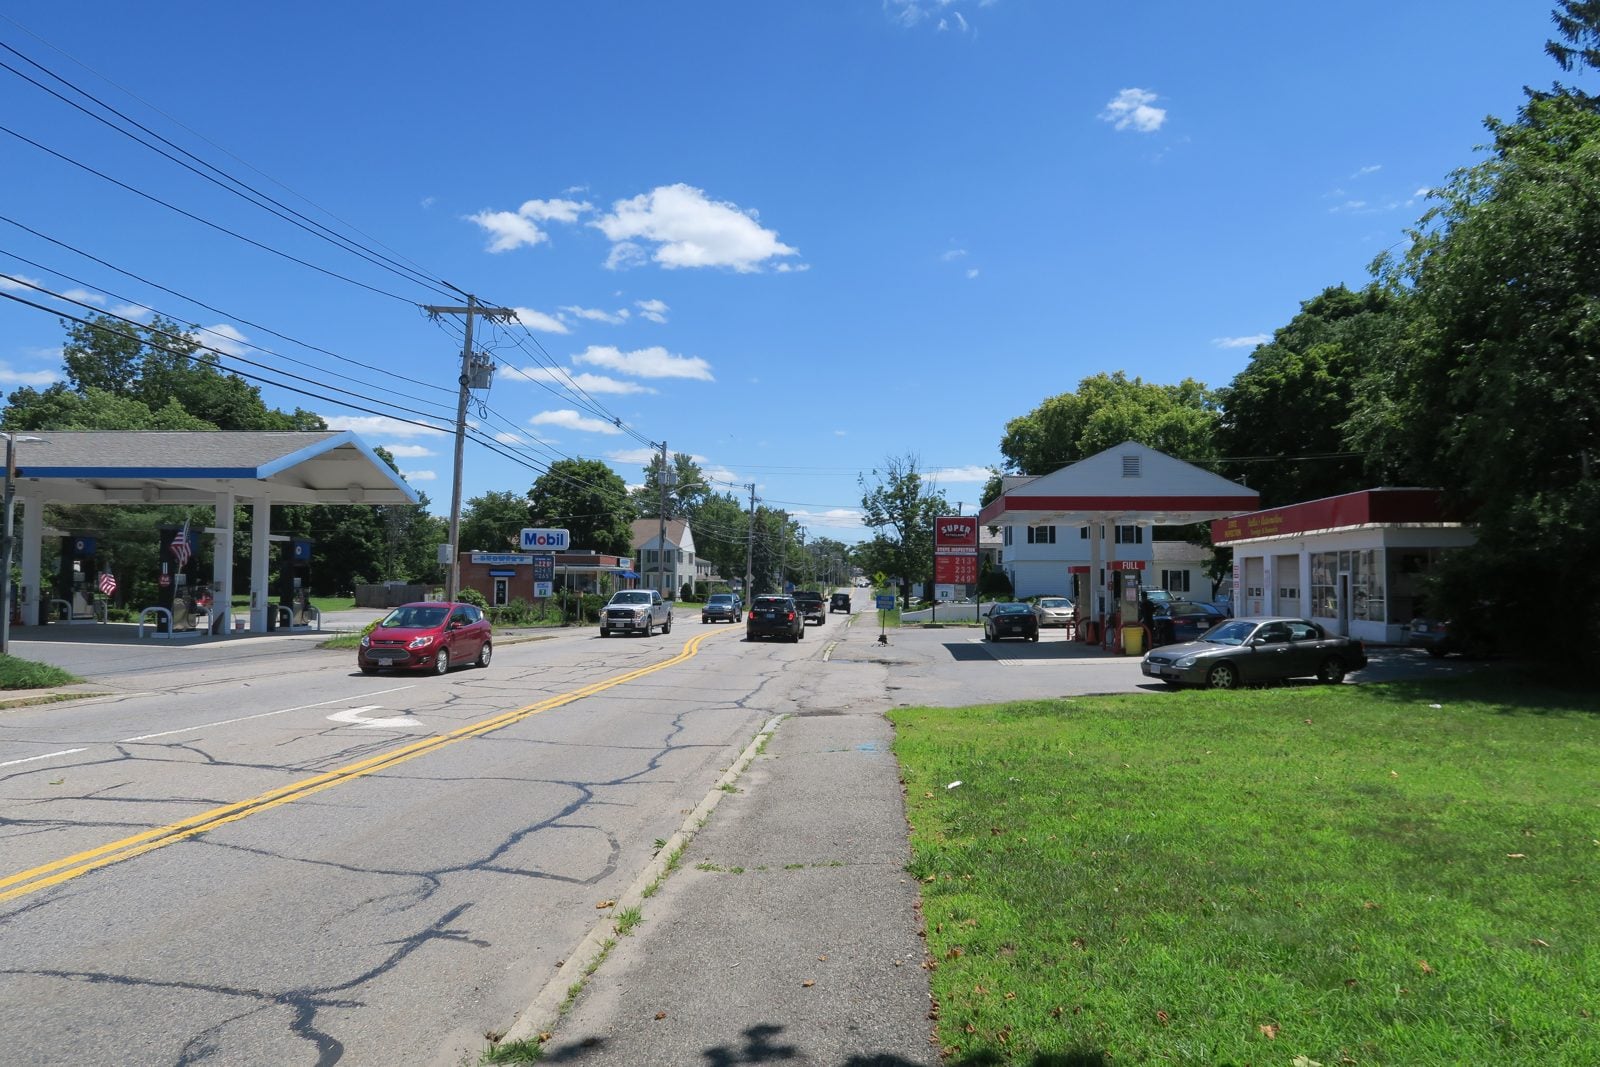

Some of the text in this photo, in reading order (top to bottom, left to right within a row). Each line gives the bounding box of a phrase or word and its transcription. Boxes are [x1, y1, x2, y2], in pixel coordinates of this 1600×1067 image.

[941, 524, 971, 534] SUPER
[524, 533, 564, 546] Mobil
[1122, 561, 1139, 570] FULL
